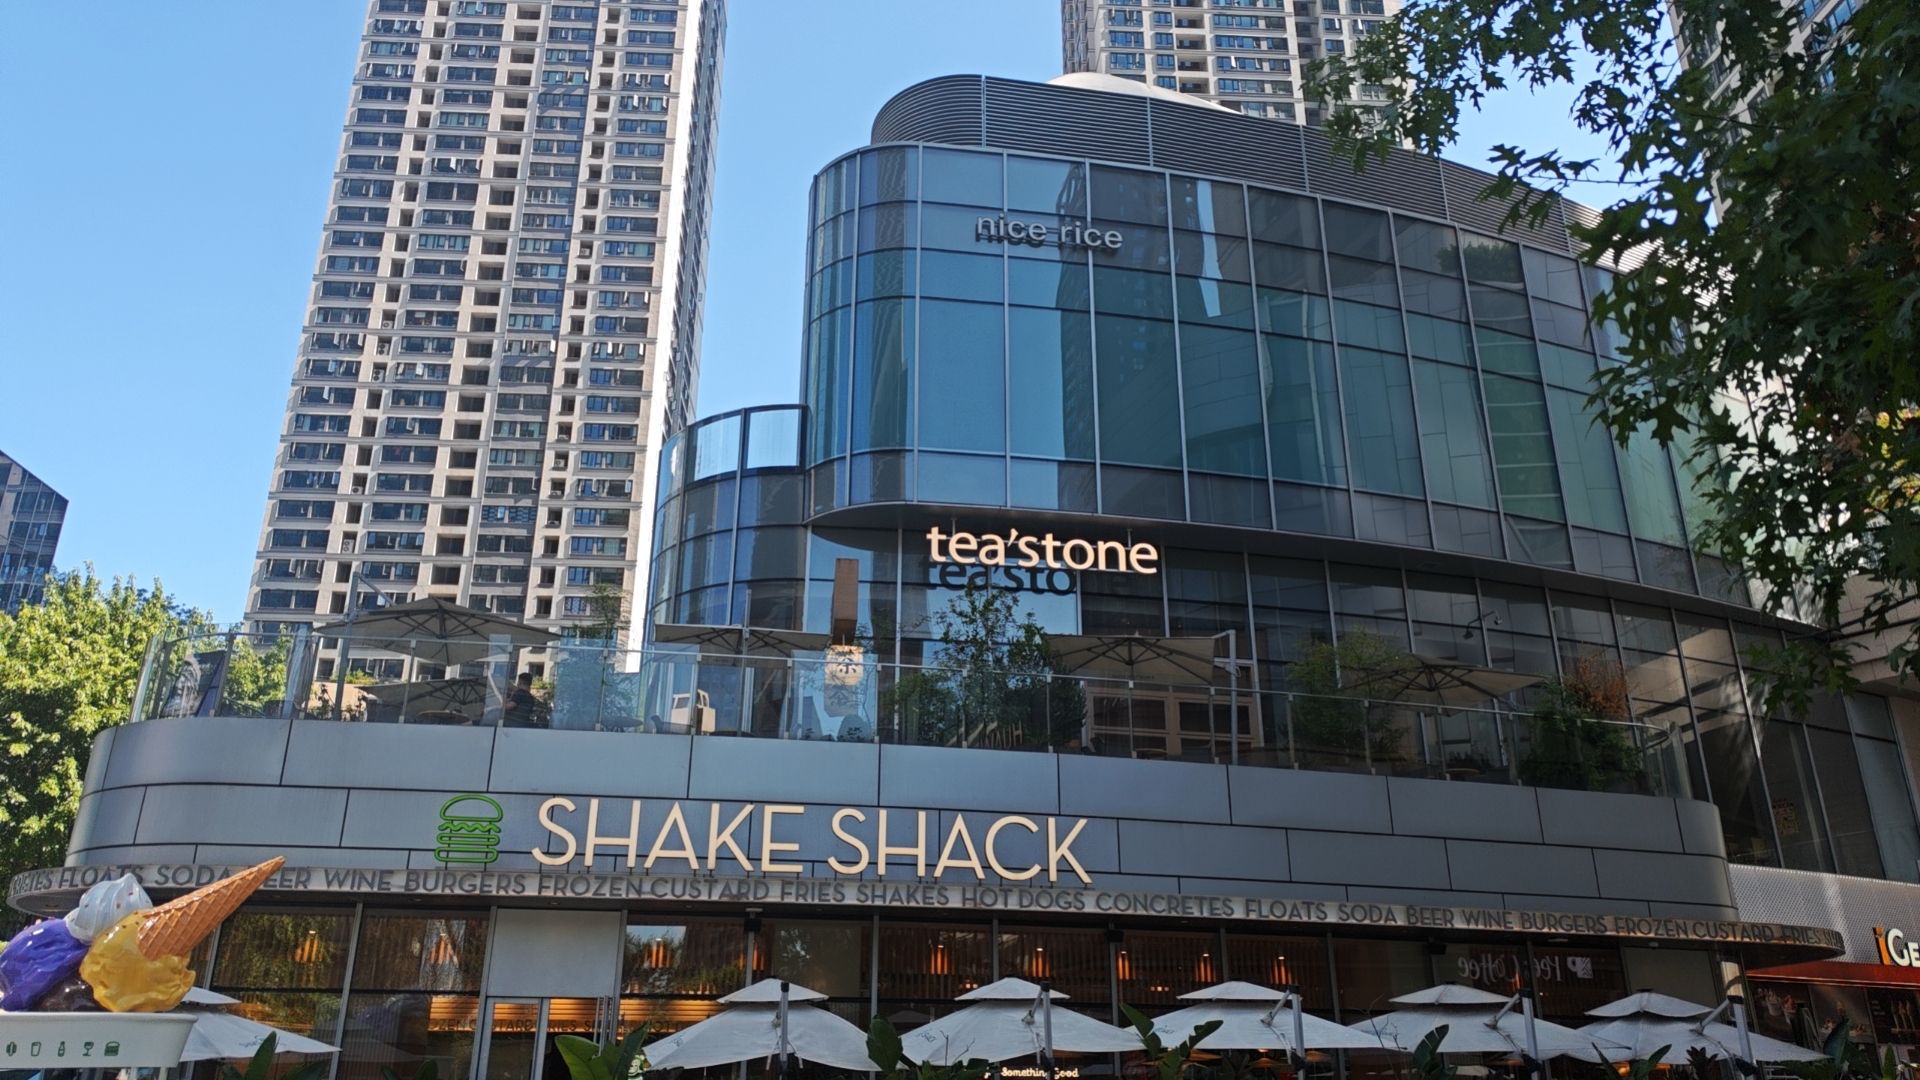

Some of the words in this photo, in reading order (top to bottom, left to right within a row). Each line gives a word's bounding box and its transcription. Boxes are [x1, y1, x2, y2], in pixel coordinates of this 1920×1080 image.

[977, 213, 1047, 241] nice
[1060, 220, 1123, 248] rice
[925, 526, 1159, 574] tea'stone
[531, 797, 806, 873] SHAKE
[827, 807, 1093, 884] SHACK
[260, 867, 312, 889] EER
[325, 869, 394, 891] WINE
[404, 870, 527, 894] BURGERS
[538, 874, 642, 897] FROZEN
[651, 877, 770, 901] CUSTARD
[780, 880, 845, 903] FRIES
[856, 884, 950, 906] SHAKES
[962, 887, 1013, 908] HOT
[1019, 889, 1085, 911] DOGS
[1095, 891, 1235, 918] CONCRETES
[1244, 899, 1328, 922] FLOATS
[1338, 903, 1398, 924] SODA
[1406, 907, 1455, 928] BEER
[1461, 909, 1515, 931] WINE
[1521, 911, 1608, 935] BURGERS
[1615, 916, 1688, 939] FROZEN
[1694, 920, 1775, 943] CUSTARD
[1781, 924, 1821, 945] FRIES
[1001, 1066, 1048, 1079] Somethin
